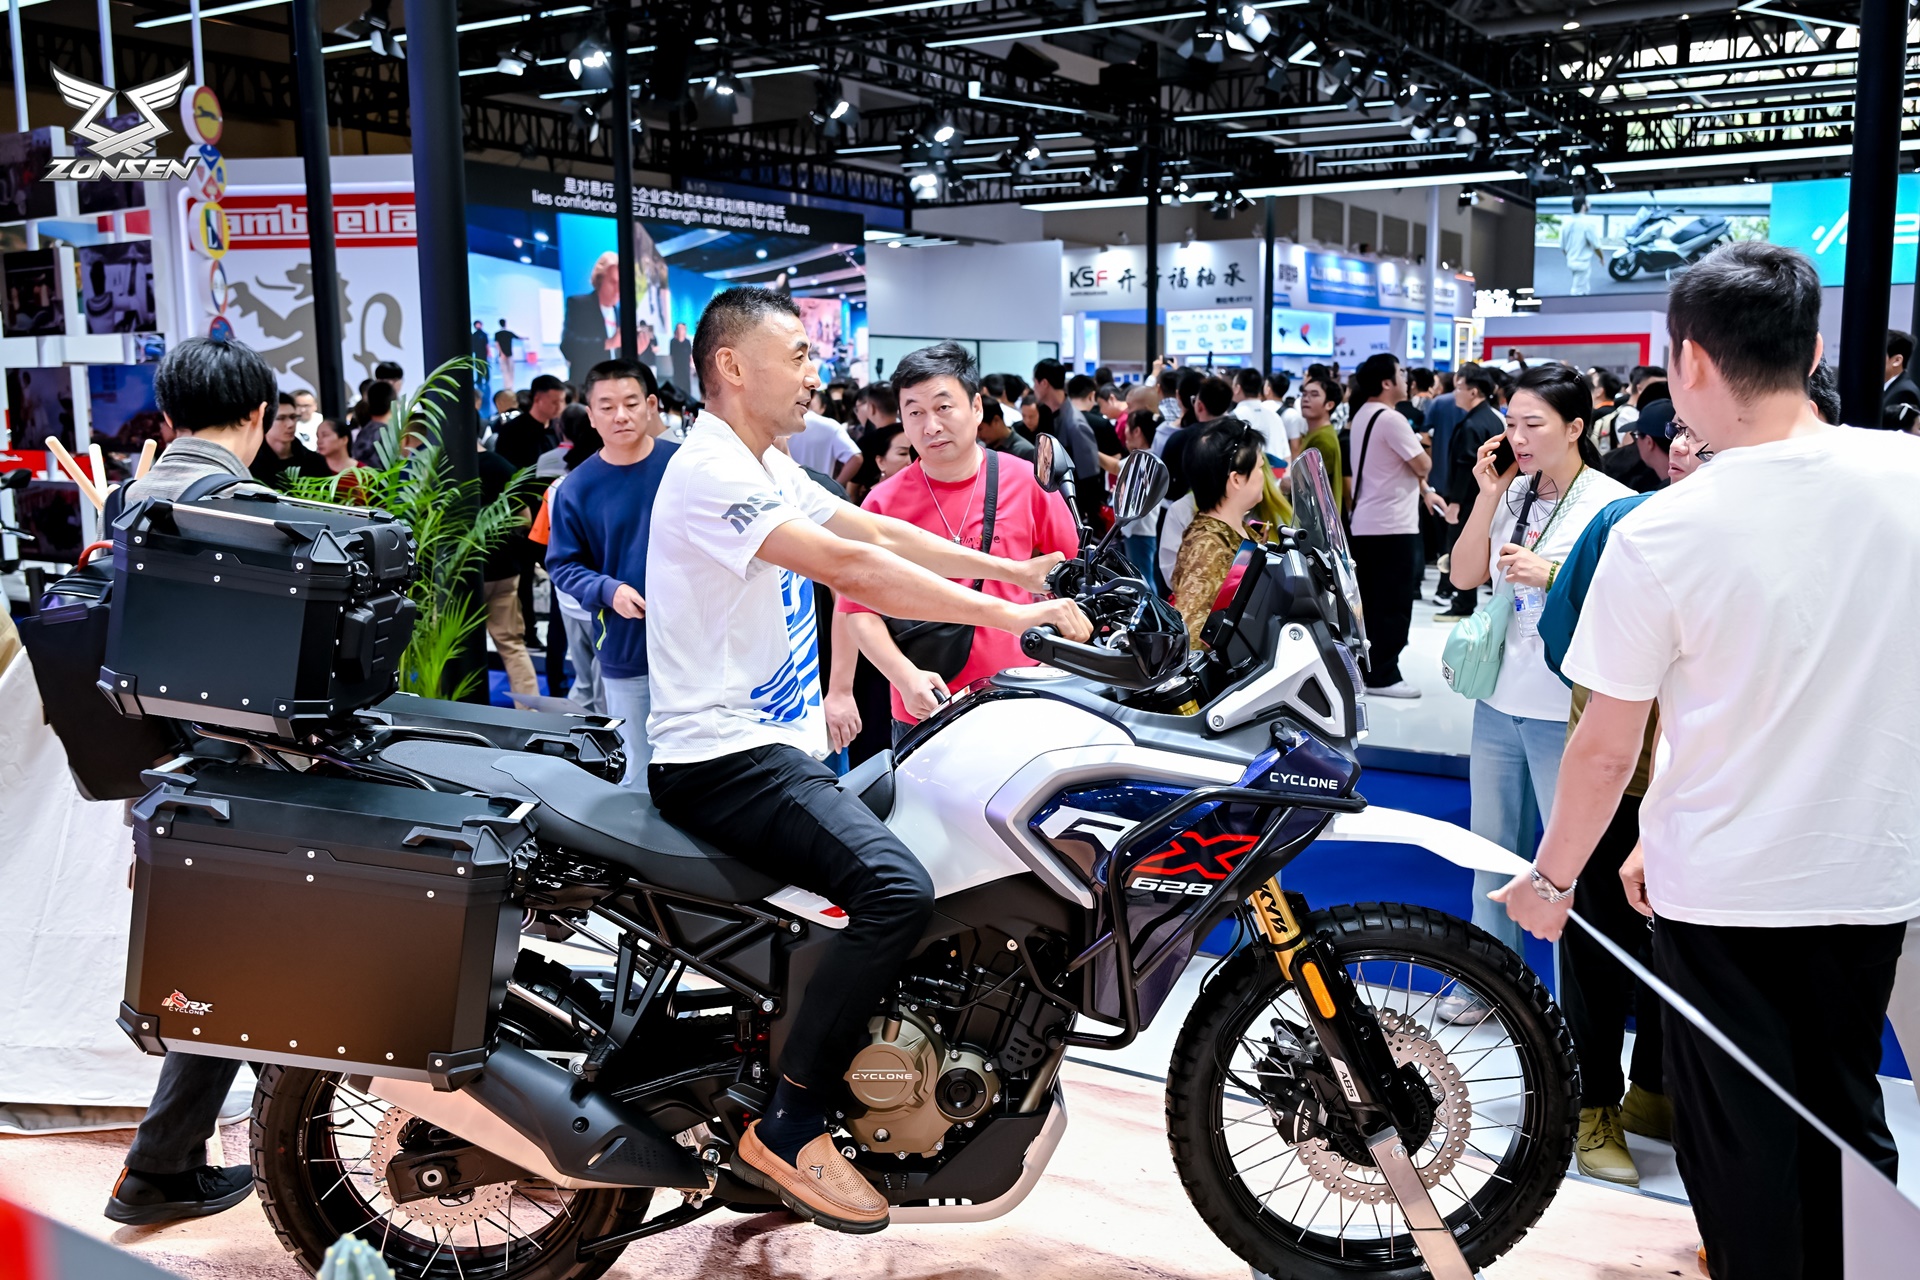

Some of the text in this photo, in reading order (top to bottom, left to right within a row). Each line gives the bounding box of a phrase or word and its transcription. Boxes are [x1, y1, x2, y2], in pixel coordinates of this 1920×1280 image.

[227, 203, 418, 237] ambetta
[532, 188, 553, 206] lies
[554, 194, 617, 213] confidence
[657, 207, 701, 225] strength
[702, 212, 722, 225] and
[723, 215, 750, 227] vision
[751, 216, 766, 230] for
[766, 219, 782, 232] the
[783, 220, 811, 235] future
[1070, 266, 1108, 288] KSF
[1269, 772, 1339, 790] CYCLONE
[1131, 877, 1214, 896] 628
[168, 1007, 204, 1015] CYCLONE
[1339, 1070, 1357, 1098] ABS
